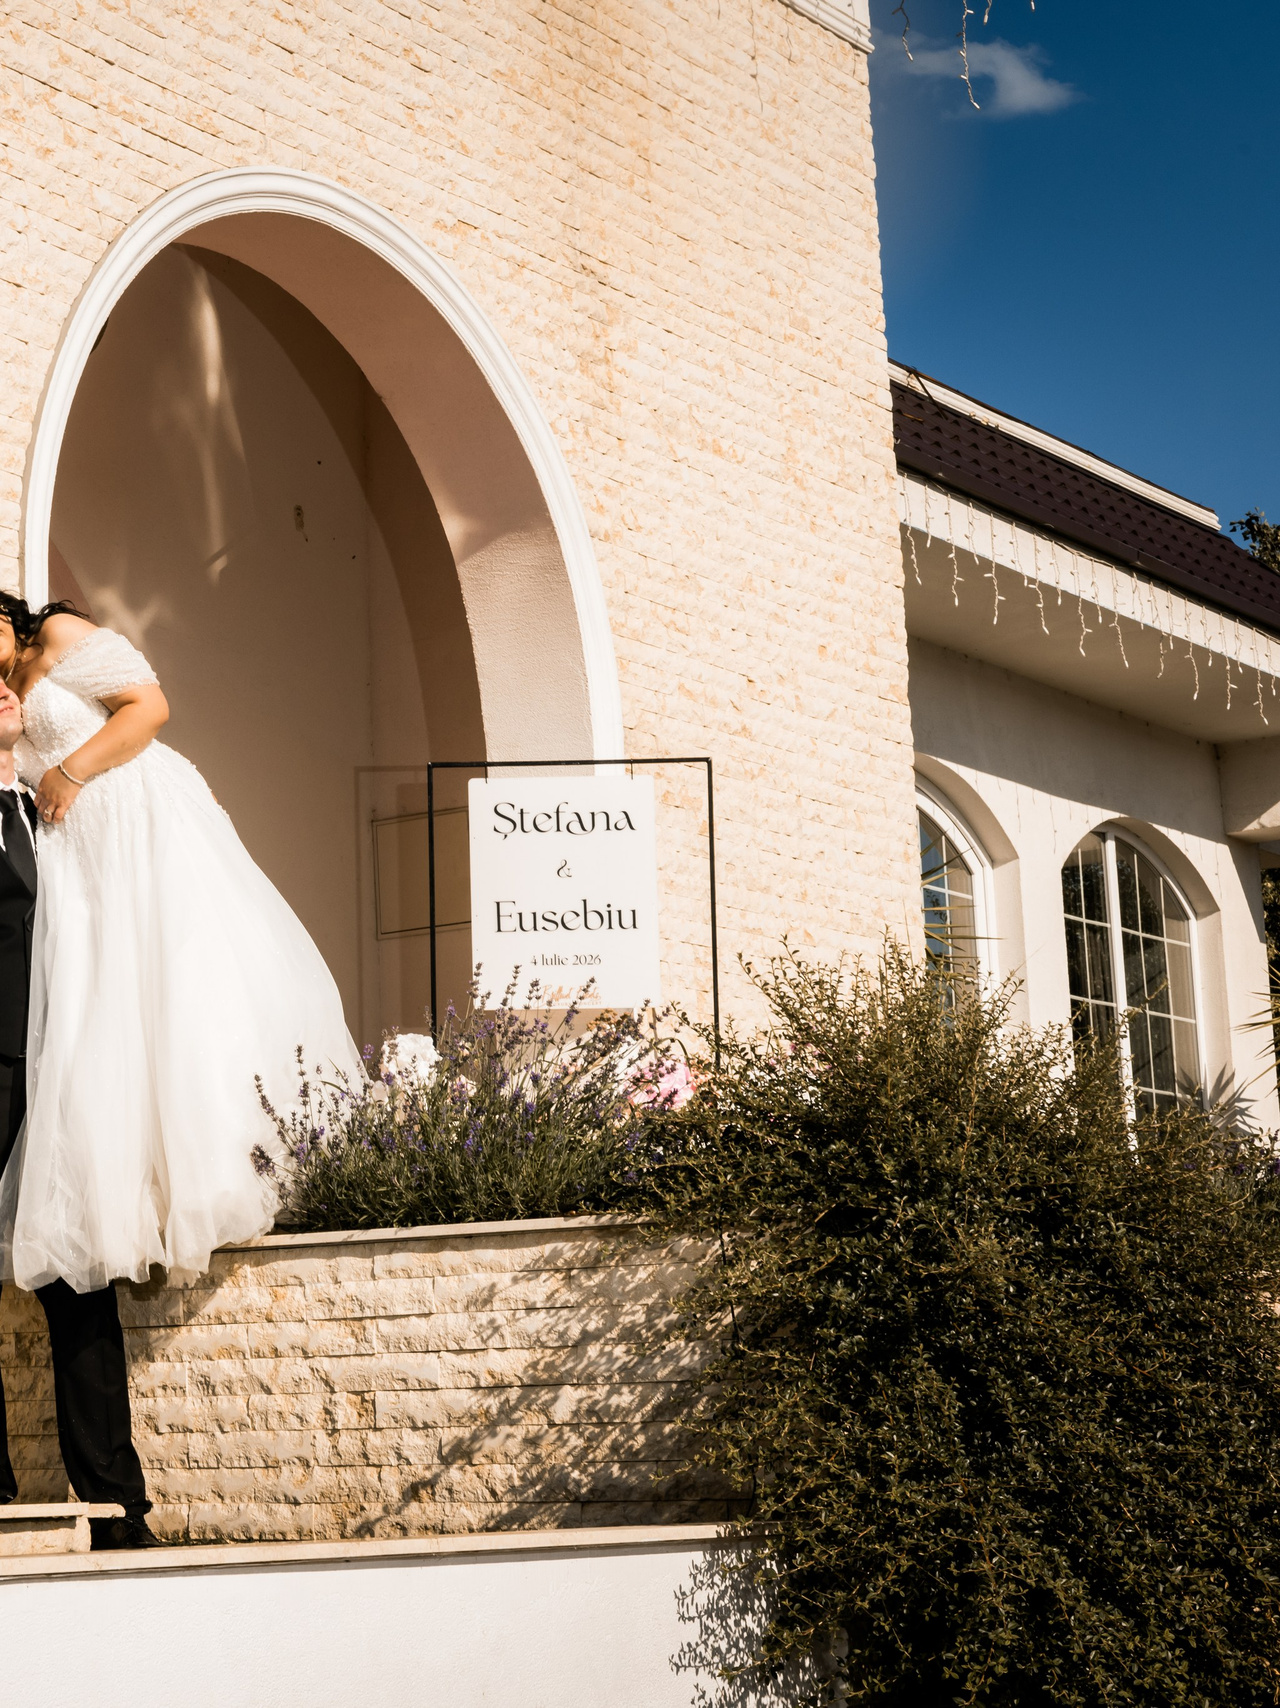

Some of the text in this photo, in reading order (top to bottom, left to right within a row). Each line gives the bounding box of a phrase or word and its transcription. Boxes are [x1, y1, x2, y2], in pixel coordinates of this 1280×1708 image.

[492, 801, 637, 841] Ștefana
[556, 858, 573, 879] &
[493, 898, 639, 933] Eusebiu
[530, 953, 602, 966] 4 Iulie 2026
